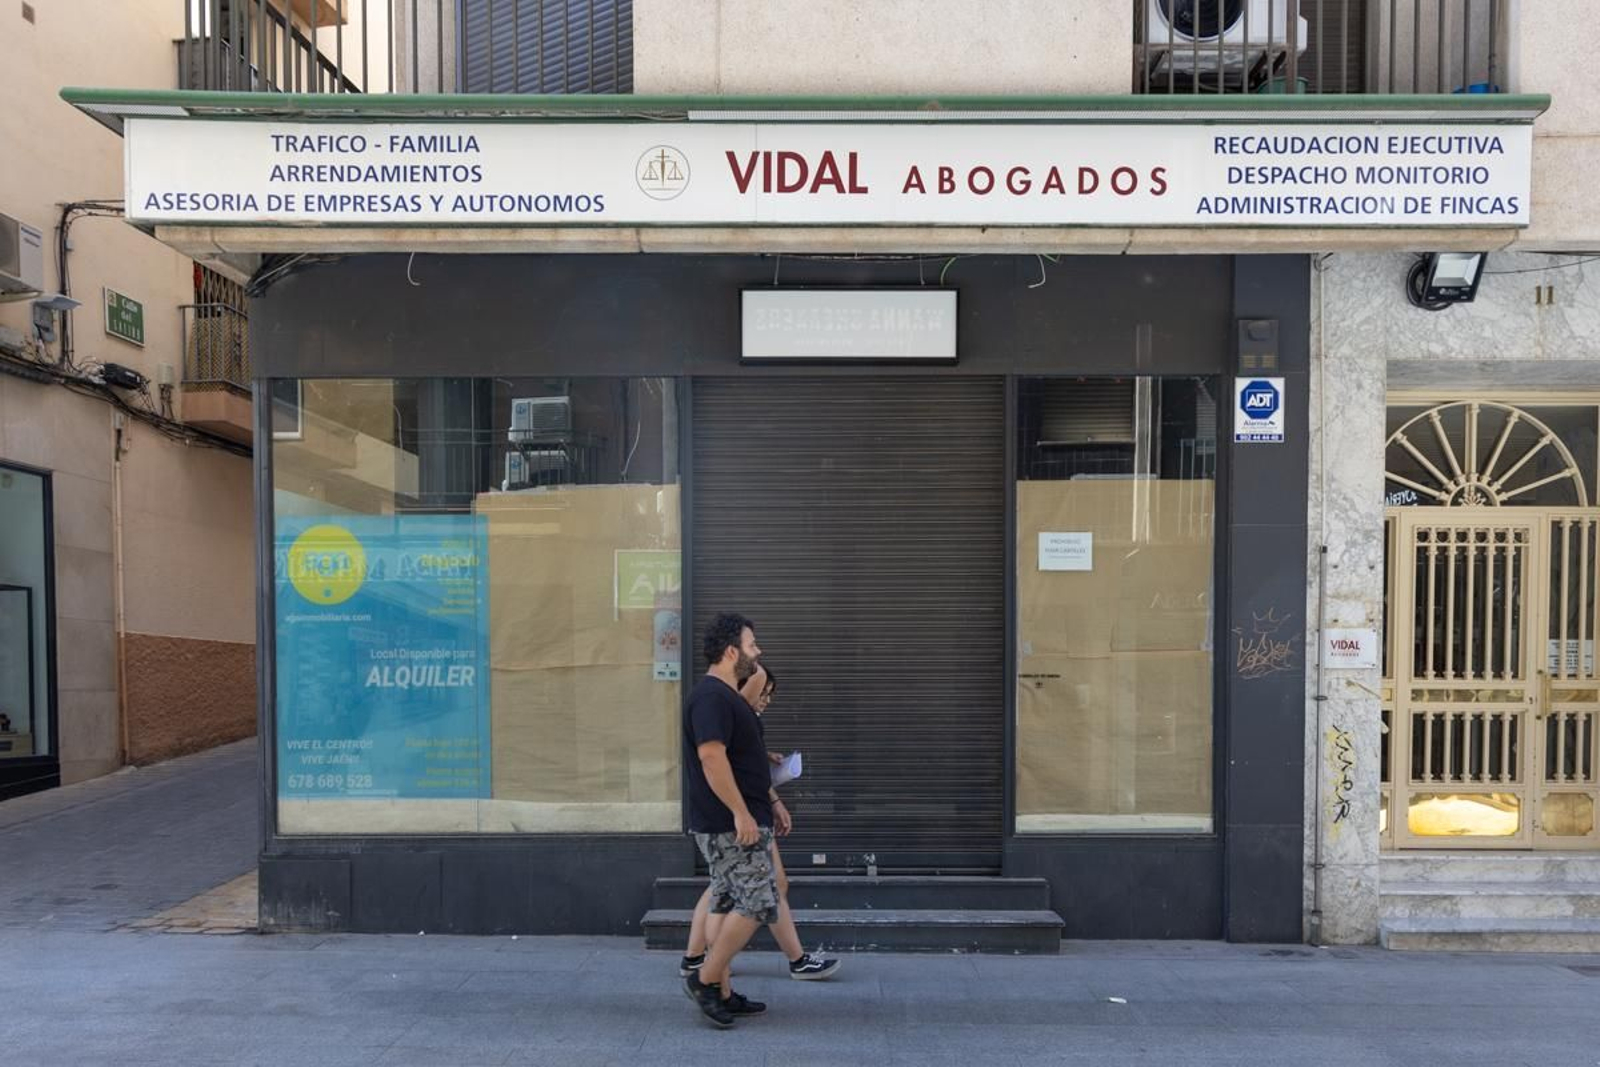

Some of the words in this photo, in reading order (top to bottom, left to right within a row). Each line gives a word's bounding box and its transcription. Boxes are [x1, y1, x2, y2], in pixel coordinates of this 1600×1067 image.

[270, 134, 367, 153] TRAFICO
[389, 135, 480, 153] FAMILIA
[1214, 136, 1379, 155] RECAUDACION
[1387, 136, 1504, 155] EJECUTIVA
[269, 164, 482, 183] ARRENDAMIENTOS
[725, 150, 869, 195] VIDAL
[902, 165, 1168, 197] ABOGADOS
[1227, 166, 1347, 185] DESPACHO
[1355, 166, 1489, 185] MONITORIO
[144, 192, 259, 213] ASESORIA
[267, 194, 295, 212] DE
[304, 194, 422, 213] EMPRESAS
[429, 195, 444, 213] Y
[451, 194, 605, 213] AUTONOMOS
[1196, 196, 1394, 215] ADMINISTRACION
[1403, 196, 1432, 214] DE
[1440, 196, 1519, 215] FINCAS
[1247, 393, 1273, 408] ADT
[1330, 639, 1361, 651] VIDAL
[370, 648, 397, 660] Local
[400, 648, 450, 661] Disponible
[452, 650, 476, 662] para
[366, 665, 475, 689] ALQUILER
[286, 739, 310, 750] VIVE
[301, 754, 325, 765] VIVE
[287, 774, 314, 789] 678
[317, 774, 343, 790] 689
[346, 774, 373, 789] 528
